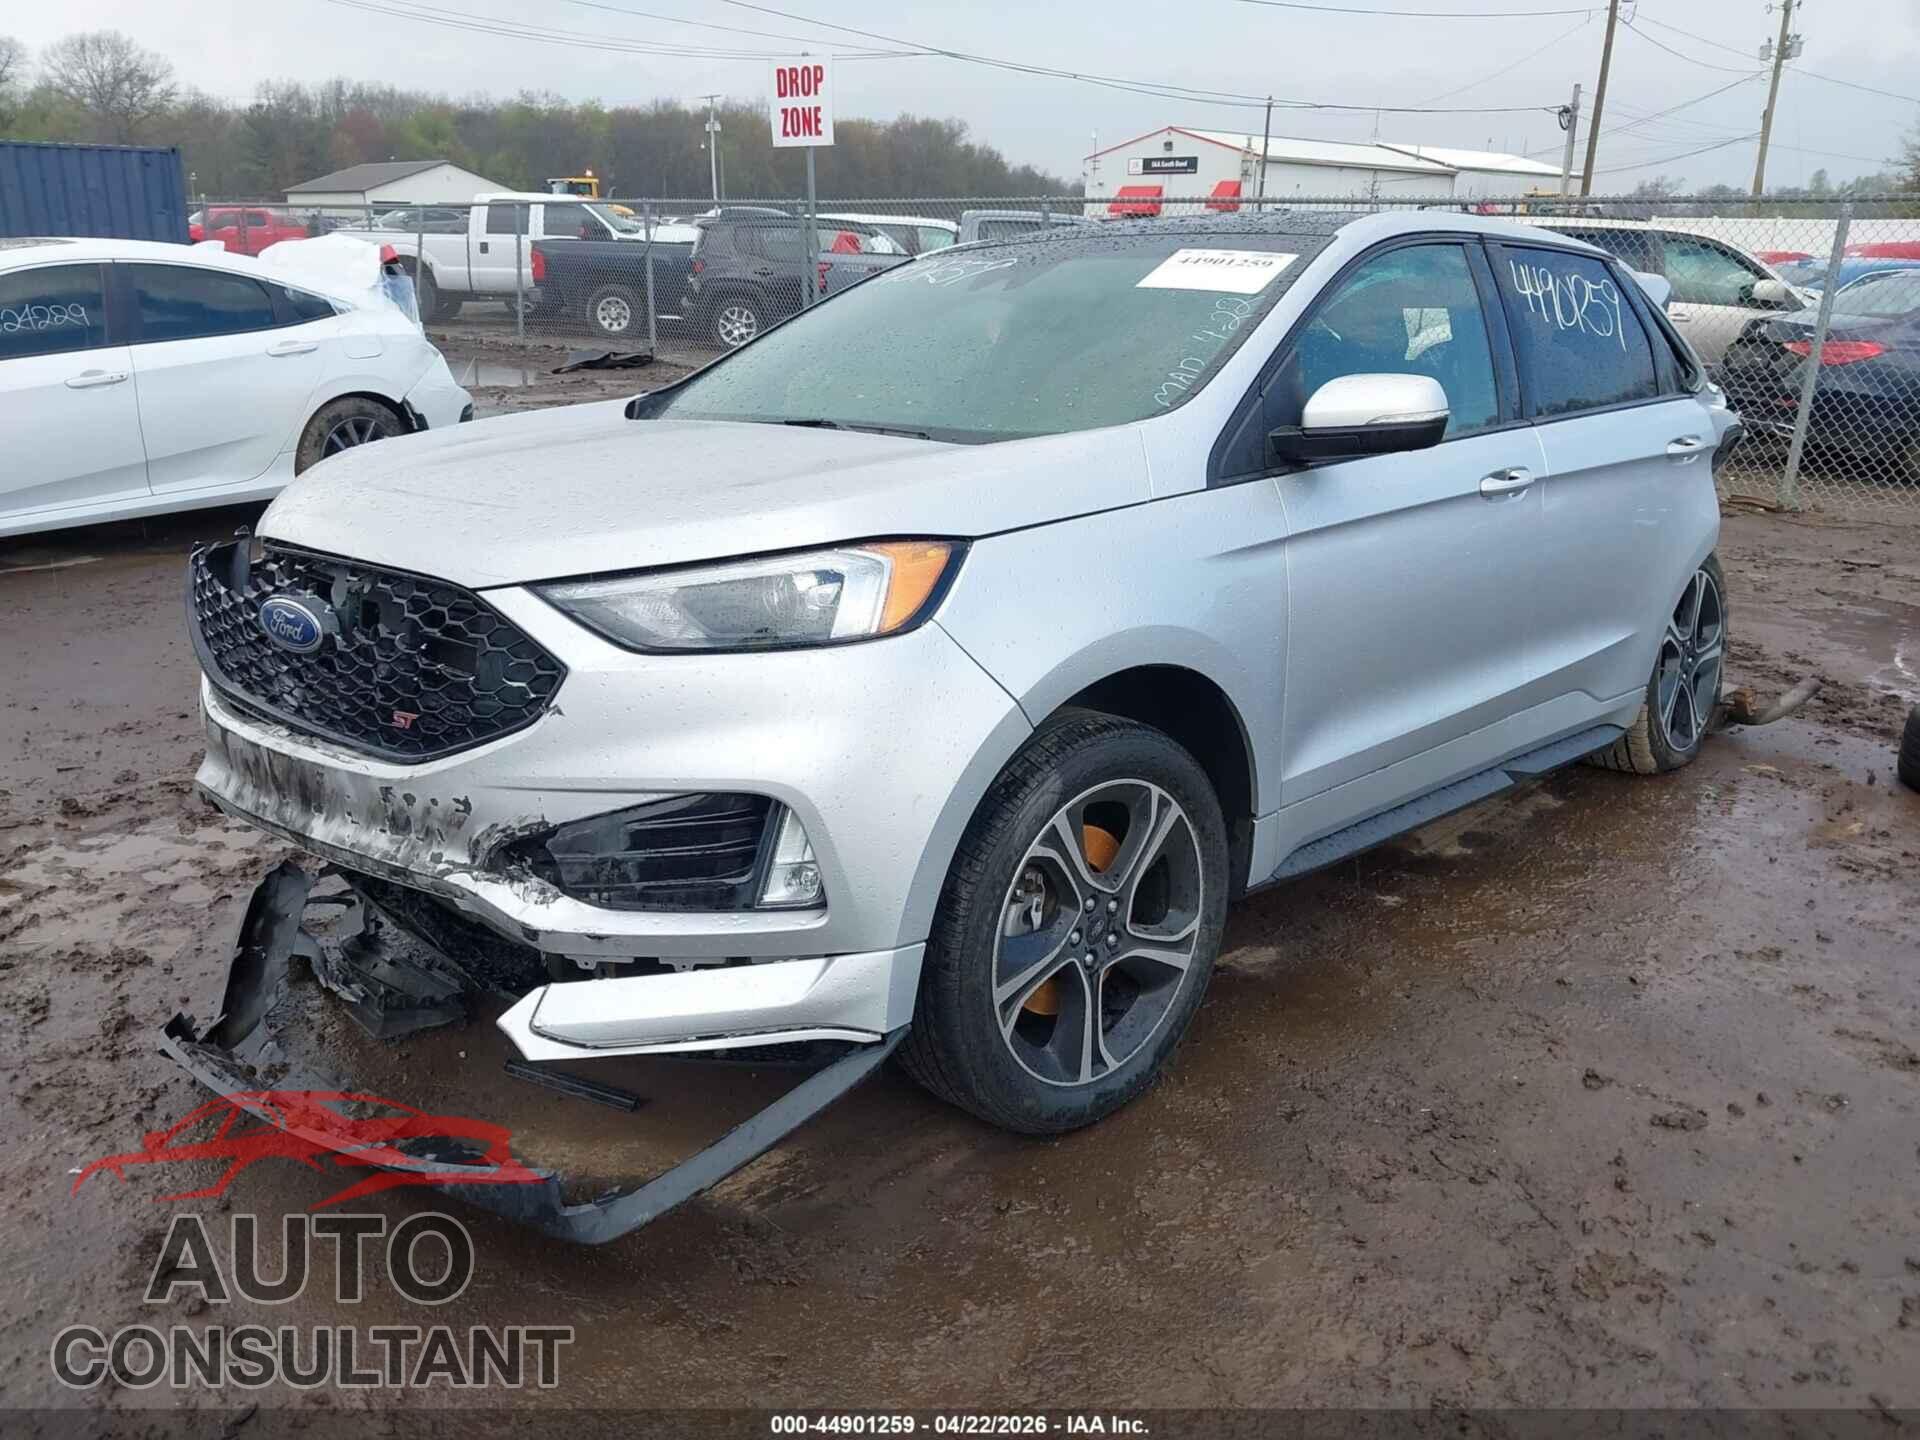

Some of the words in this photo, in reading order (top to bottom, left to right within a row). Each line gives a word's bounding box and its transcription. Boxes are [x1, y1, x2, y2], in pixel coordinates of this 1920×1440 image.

[776, 65, 823, 98] DROP
[781, 106, 823, 137] ZONE
[269, 607, 304, 641] Ford
[391, 710, 419, 729] ST
